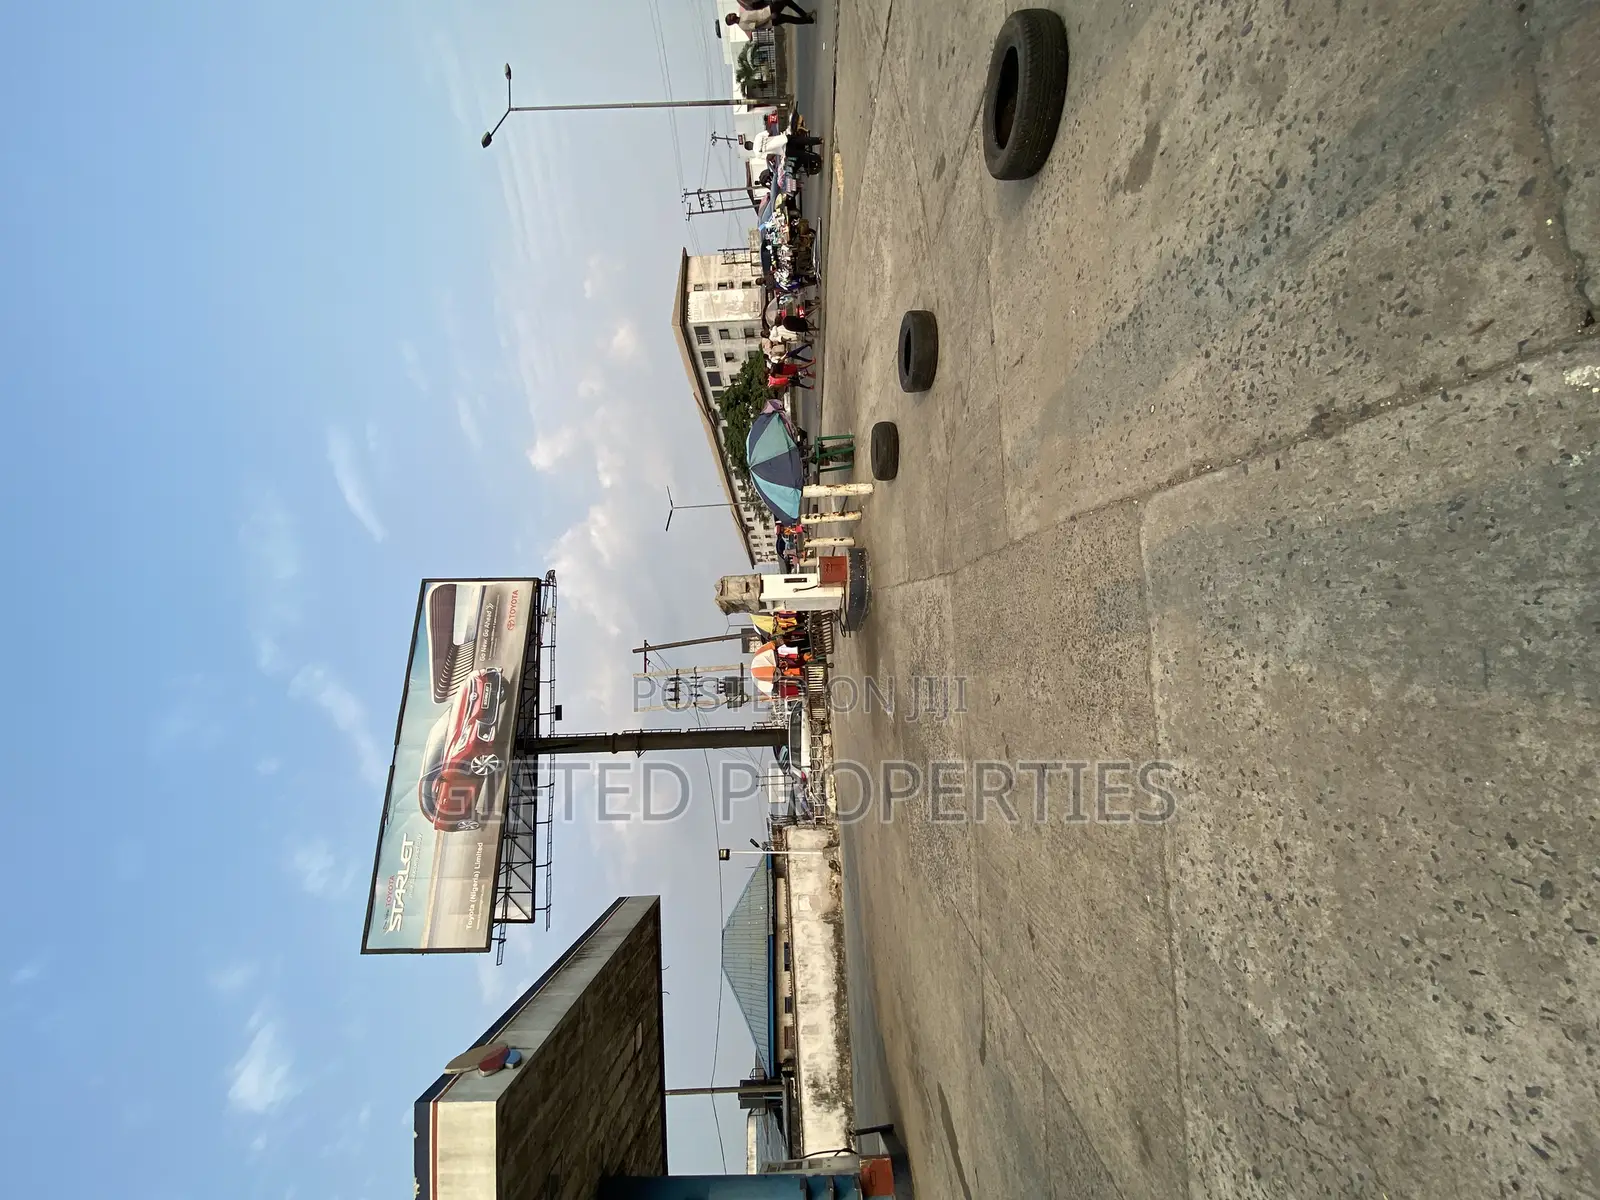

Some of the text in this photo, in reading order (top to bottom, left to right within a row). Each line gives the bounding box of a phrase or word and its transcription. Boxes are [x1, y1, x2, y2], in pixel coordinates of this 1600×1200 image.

[484, 611, 492, 628] Ahead
[509, 589, 518, 620] TOYOTA
[483, 629, 489, 637] Go
[480, 653, 486, 662] Go
[384, 833, 414, 936] STARLET
[386, 875, 395, 907] TOYOTA
[466, 842, 484, 930] Toyota (Nigeria) Limited
